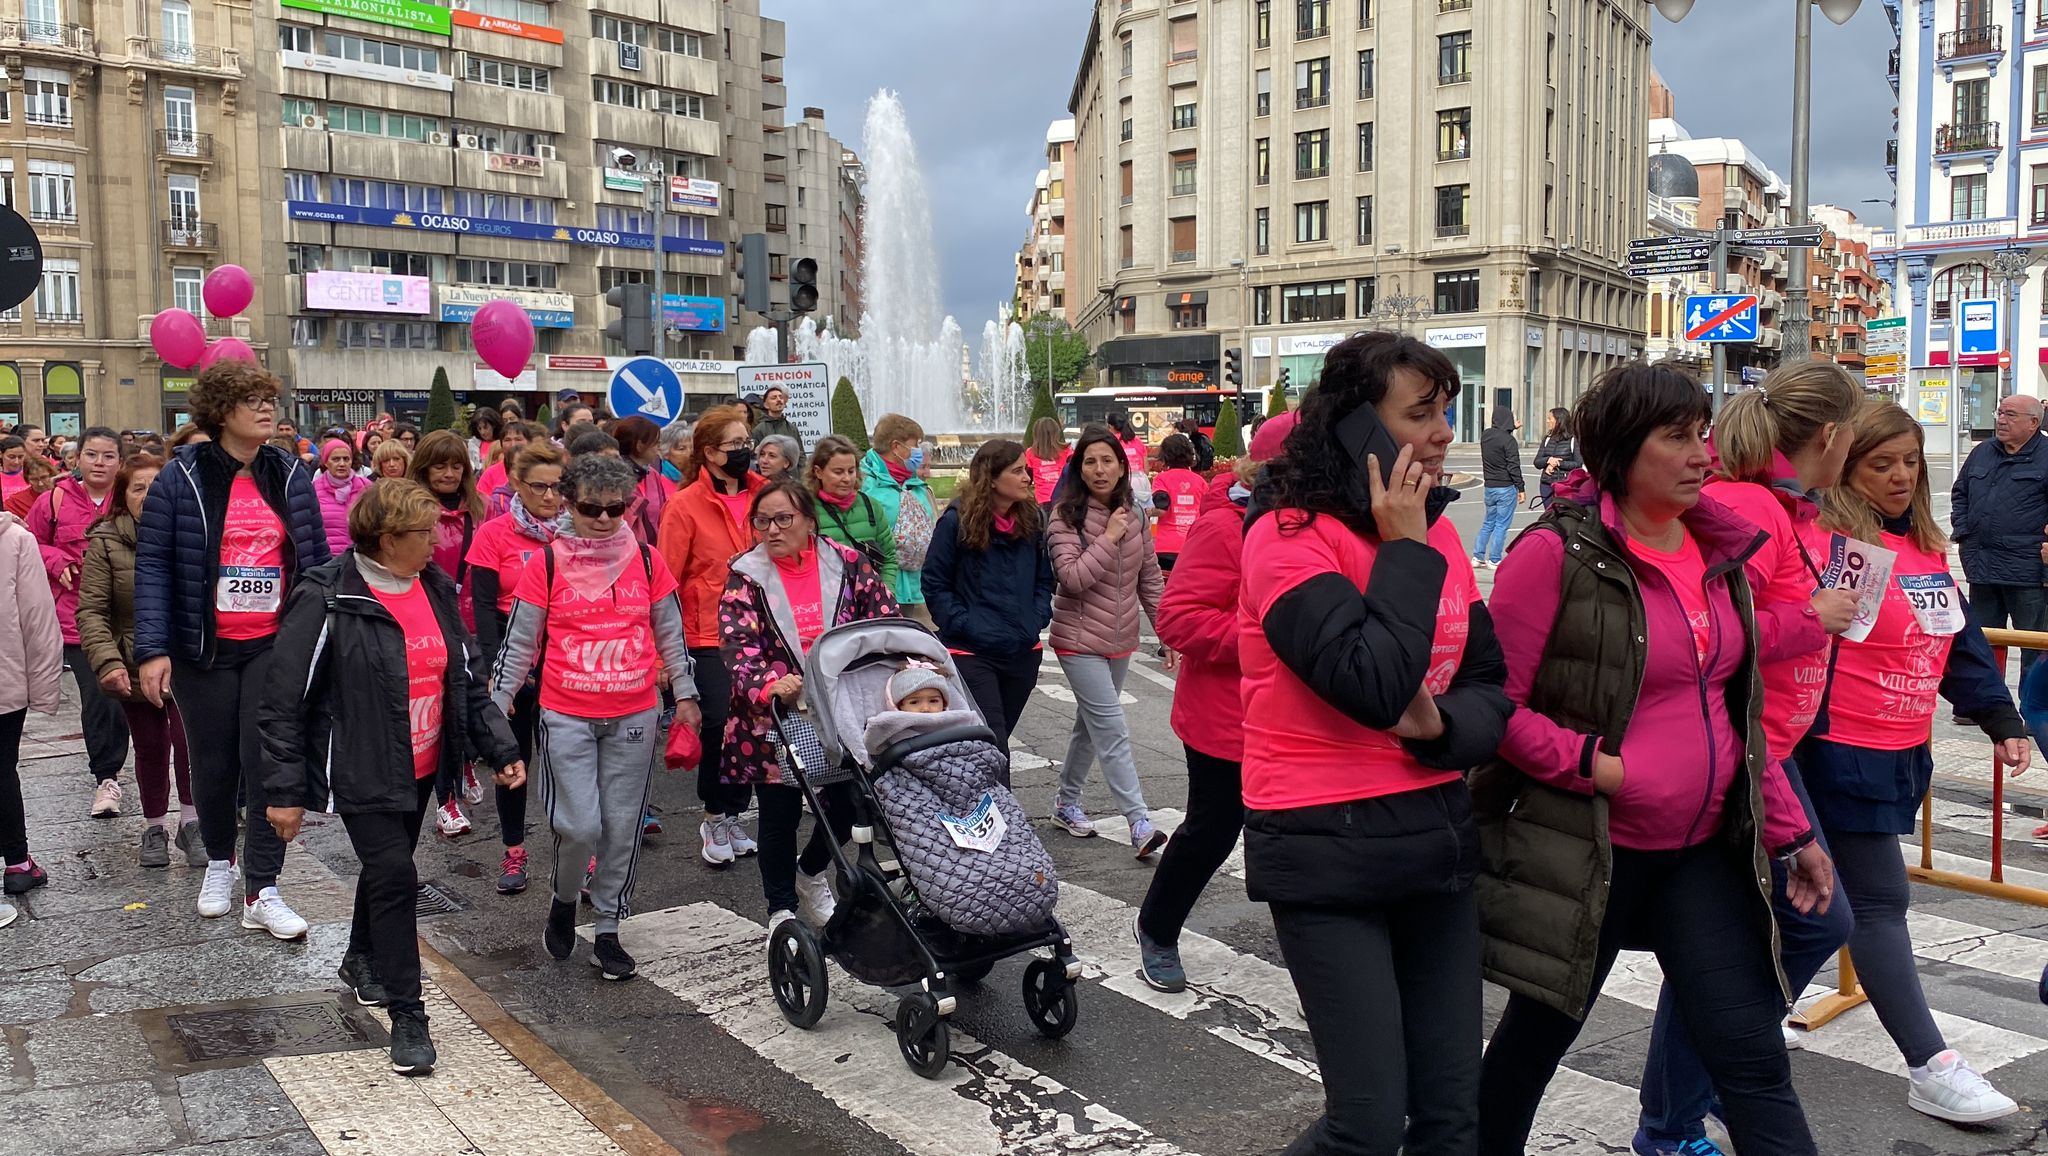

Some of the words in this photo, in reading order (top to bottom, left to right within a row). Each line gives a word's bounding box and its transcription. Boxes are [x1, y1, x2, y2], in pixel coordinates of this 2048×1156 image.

[295, 209, 345, 221] www.ocaso.es
[421, 214, 470, 231] OCASO
[474, 223, 512, 235] SEGUROS
[577, 229, 620, 245] OCASO
[623, 237, 656, 249] SEGUROS
[328, 285, 379, 303] GENTE
[450, 289, 459, 300] La
[462, 290, 489, 302] Nueva
[545, 295, 569, 307] ABC
[1428, 332, 1485, 342] VITALDENT
[1294, 339, 1343, 349] VITALDEN
[668, 361, 698, 371] NOMIA
[700, 361, 722, 371] ZERO
[754, 371, 812, 382] ATENCIÓN
[1167, 370, 1205, 384] Orange
[740, 384, 769, 392] SALIDA
[785, 381, 826, 390] TOMÁTICA
[331, 390, 375, 402] PASTOR
[420, 391, 431, 399] Ho
[792, 401, 825, 409] MARCHA
[785, 410, 819, 418] MÁFORO
[1838, 552, 1865, 590] 20
[228, 580, 273, 594] 2889
[1907, 590, 1949, 610] 3970
[562, 670, 611, 682] CARRERA
[1878, 671, 1907, 691] VIII
[1907, 677, 1941, 692] CARRE
[561, 679, 601, 693] ALMOM
